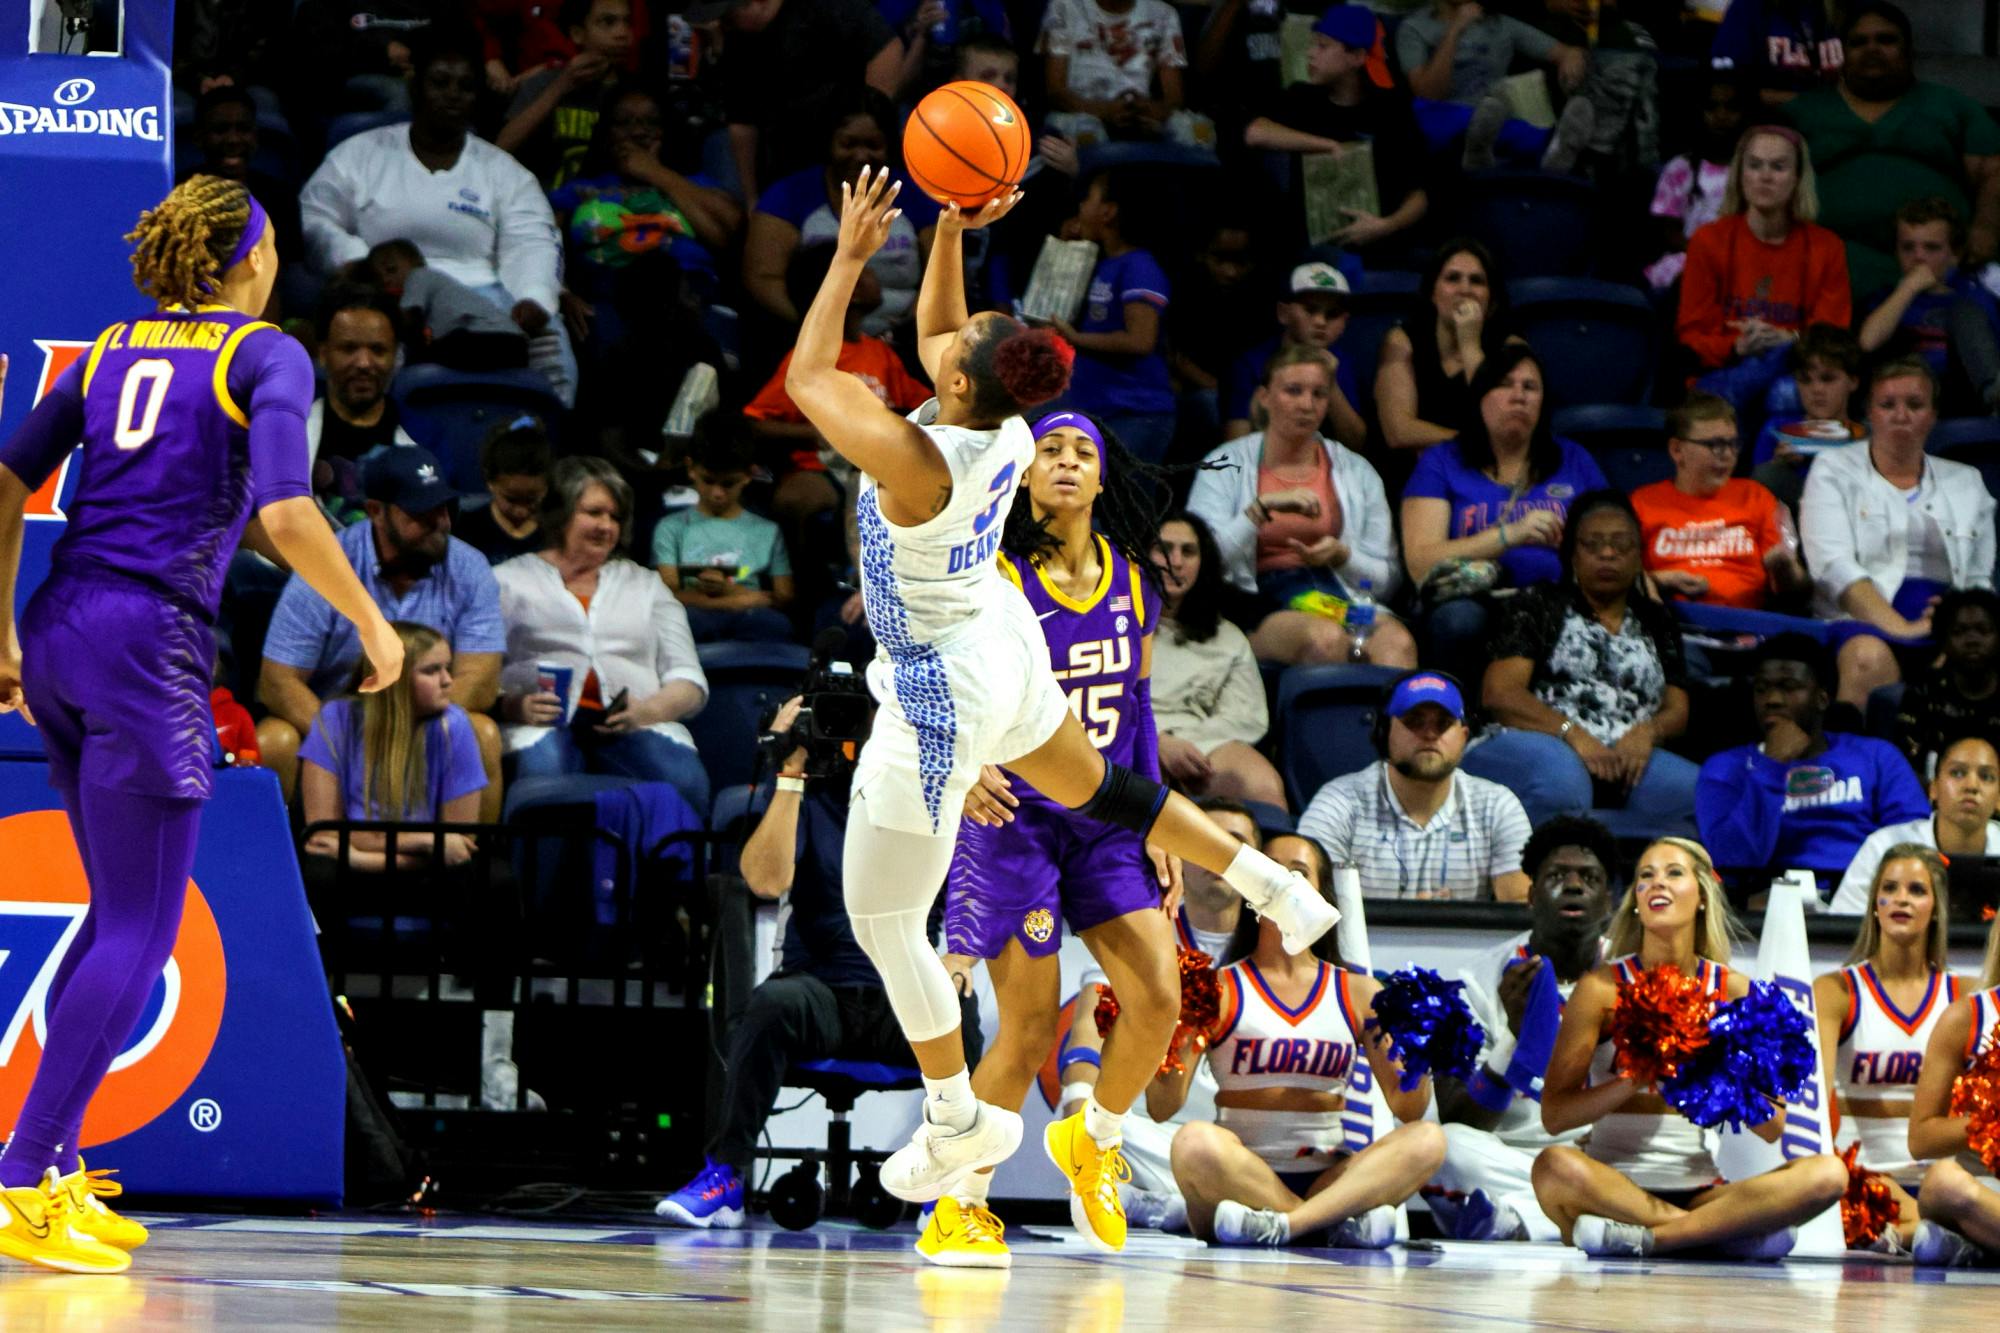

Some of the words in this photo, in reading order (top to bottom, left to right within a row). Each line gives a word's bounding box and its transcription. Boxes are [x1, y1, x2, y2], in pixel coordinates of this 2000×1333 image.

[128, 320, 229, 352] WILLIAMS
[114, 358, 175, 450] 0
[1055, 635, 1132, 681] SU
[1851, 1051, 1923, 1085] FLOR
